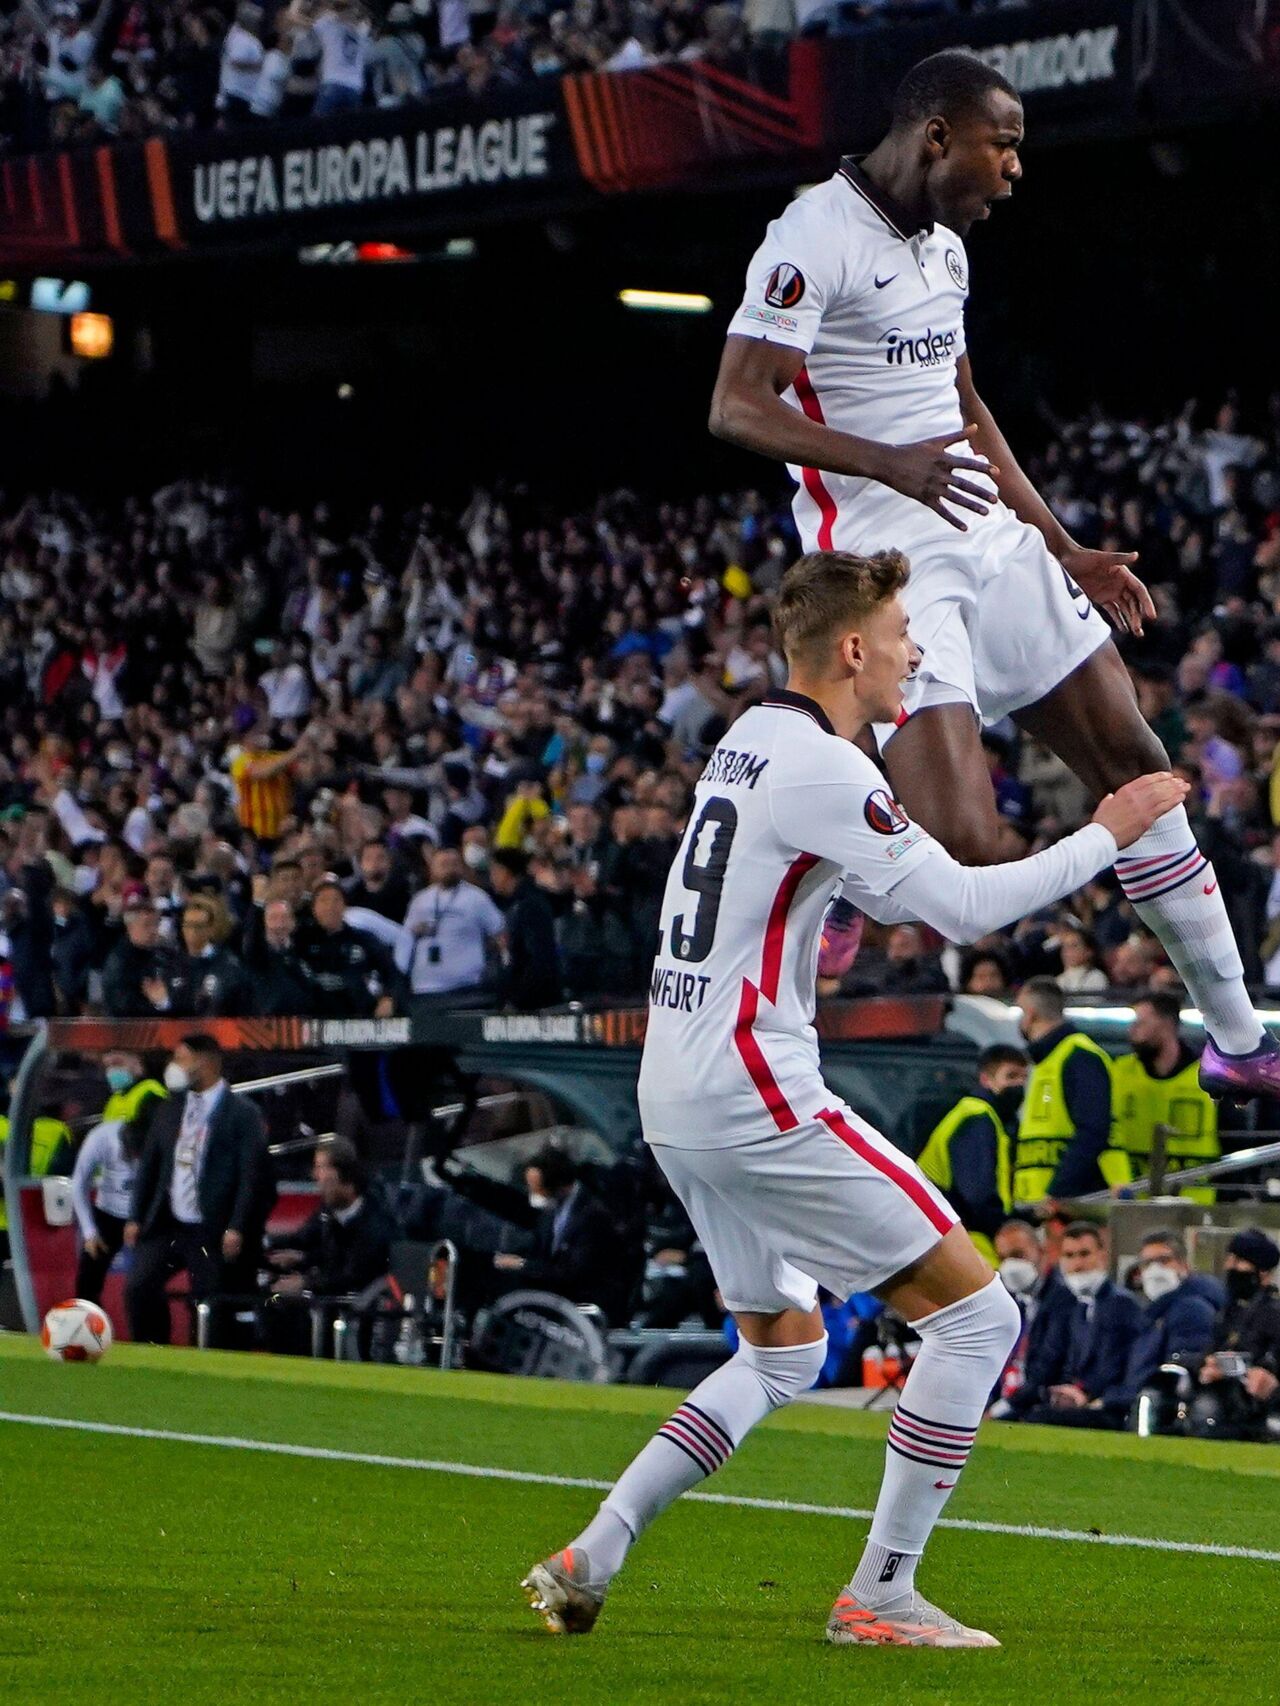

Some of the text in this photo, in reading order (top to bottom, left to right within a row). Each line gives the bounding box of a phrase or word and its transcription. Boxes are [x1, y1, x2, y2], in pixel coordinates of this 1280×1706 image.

[194, 113, 550, 221] UEFA EUROPA LEAGUE
[885, 327, 957, 366] indee
